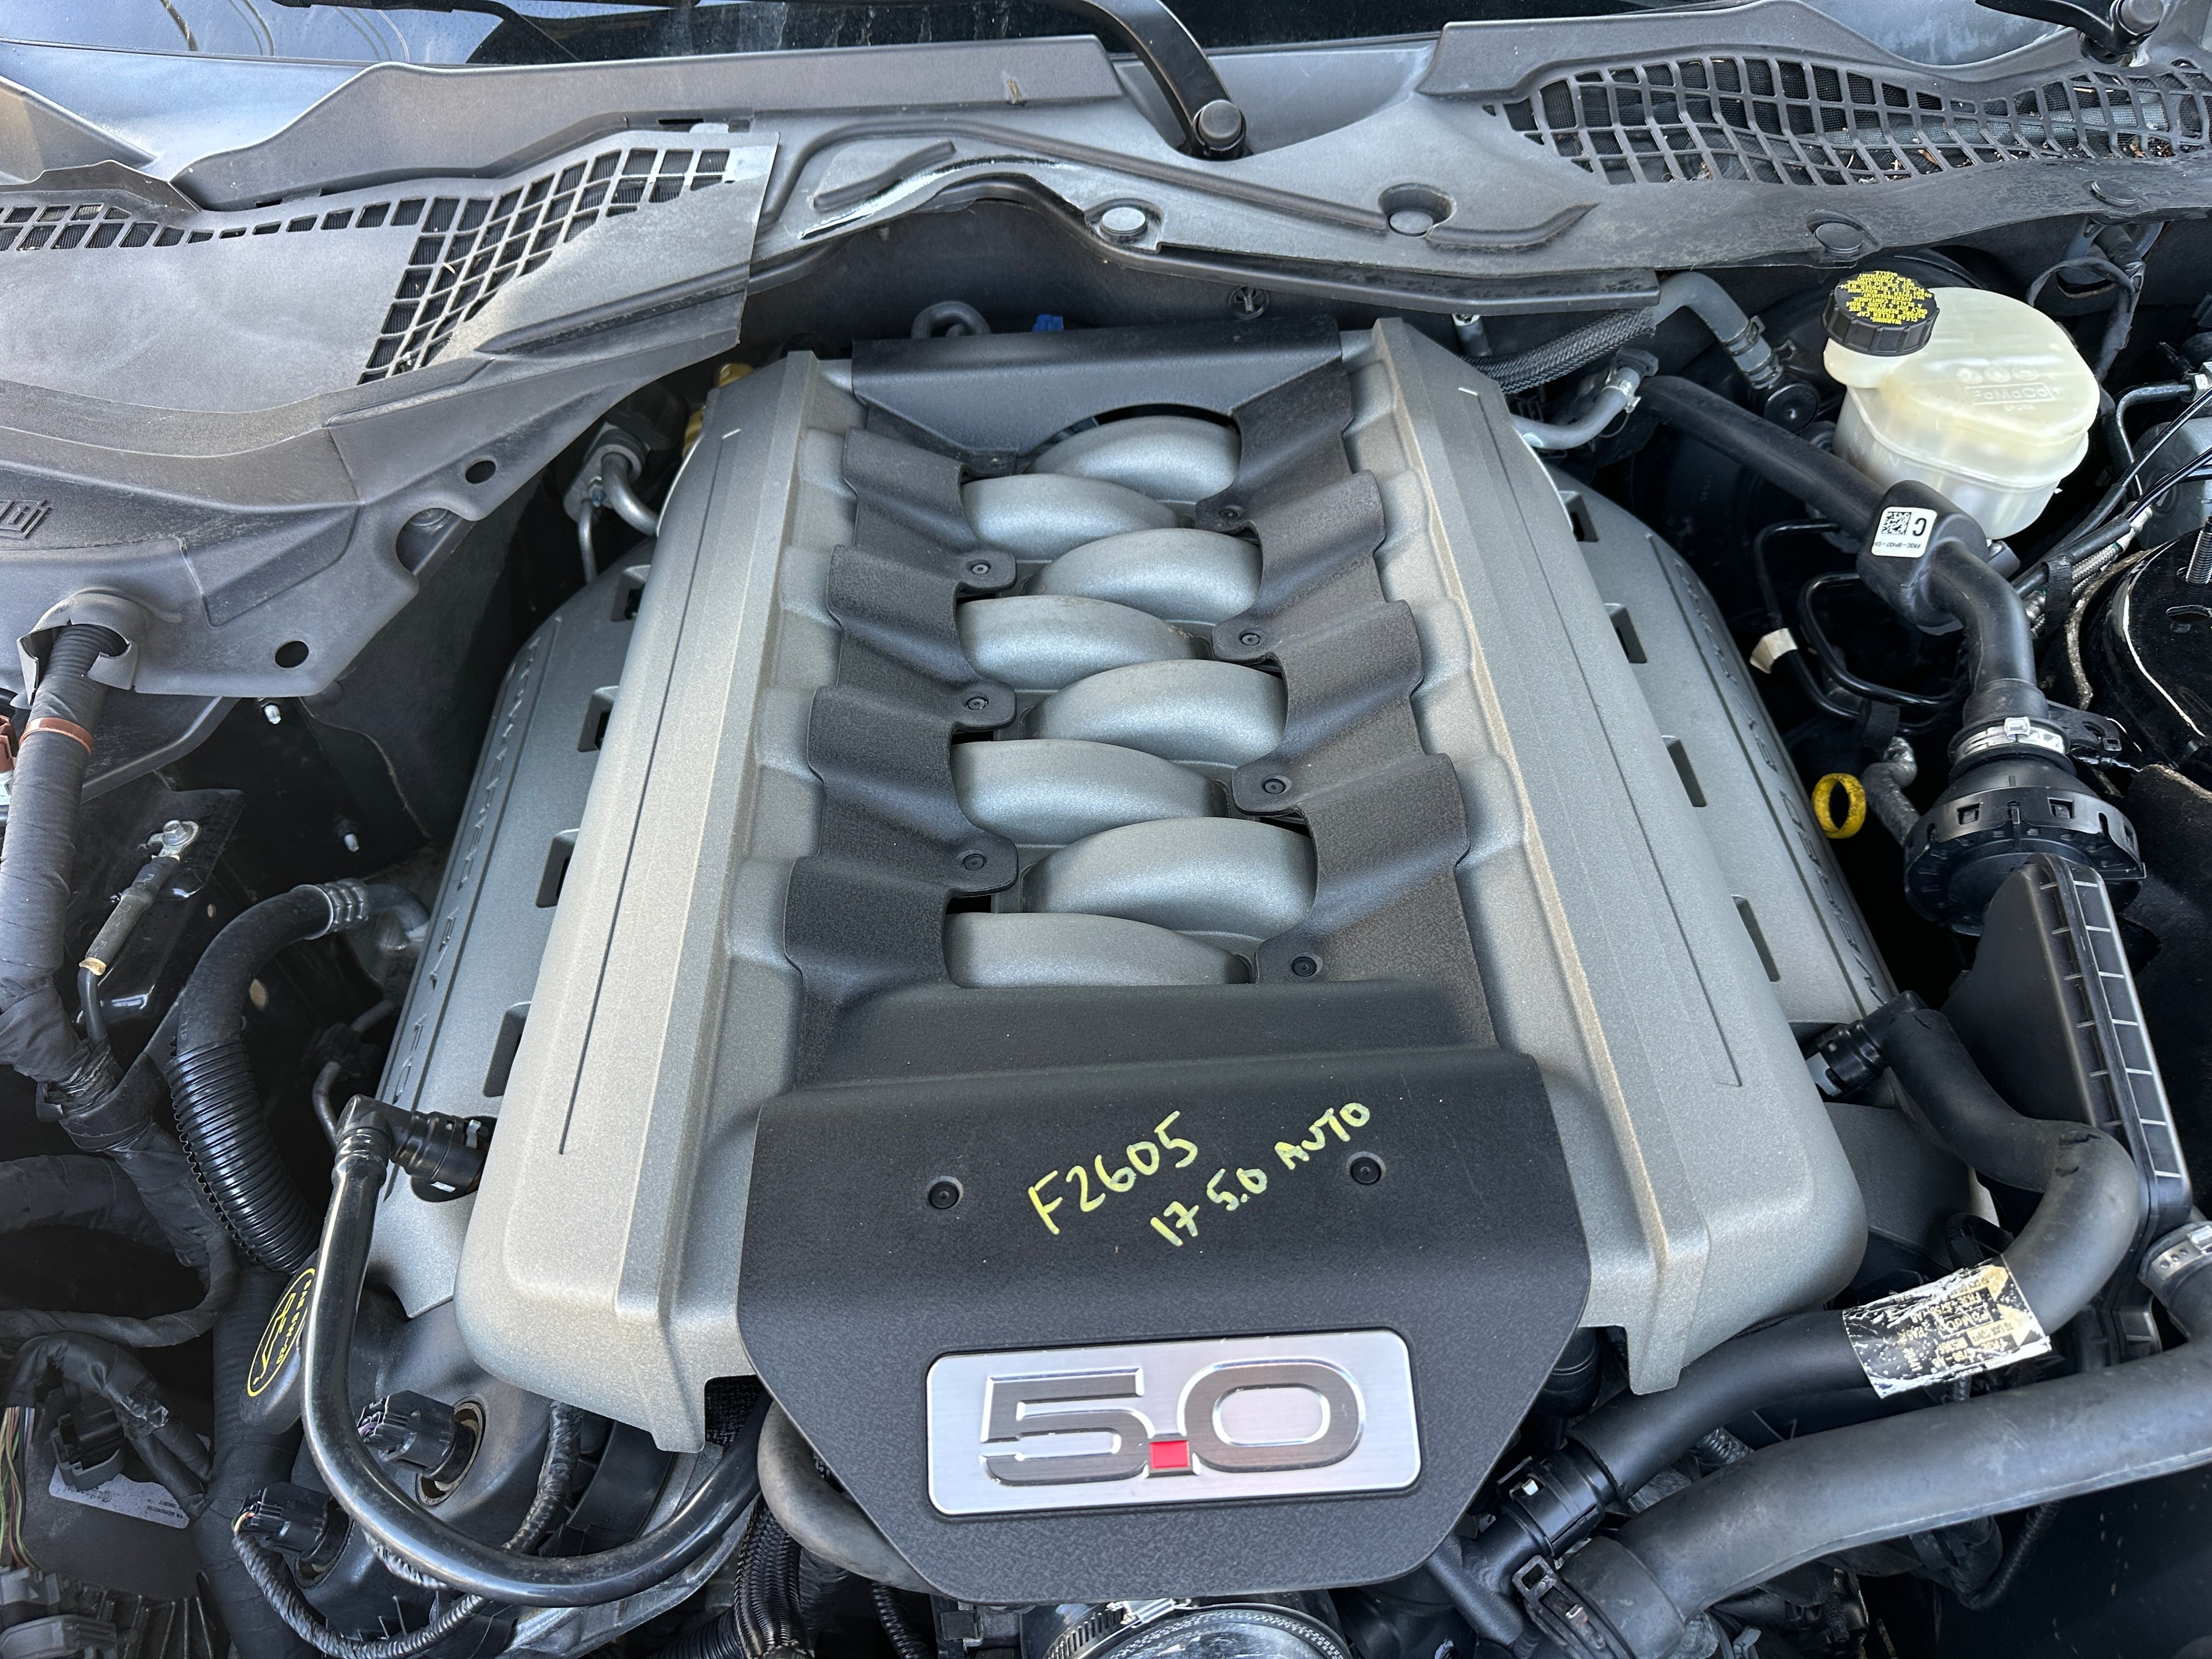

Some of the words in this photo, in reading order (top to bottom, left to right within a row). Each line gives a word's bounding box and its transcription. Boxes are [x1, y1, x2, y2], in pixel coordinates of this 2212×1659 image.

[1867, 301, 1886, 309] FLUID
[1891, 300, 1915, 308] SEALED
[1912, 517, 1927, 537] C
[1028, 1110, 1198, 1235] F2605
[1150, 1200, 1199, 1247] 17
[1206, 1168, 1268, 1211] 5.0
[1274, 1102, 1370, 1169] AUTO
[296, 1279, 312, 1310] SAE
[979, 1357, 1365, 1487] 5.0
